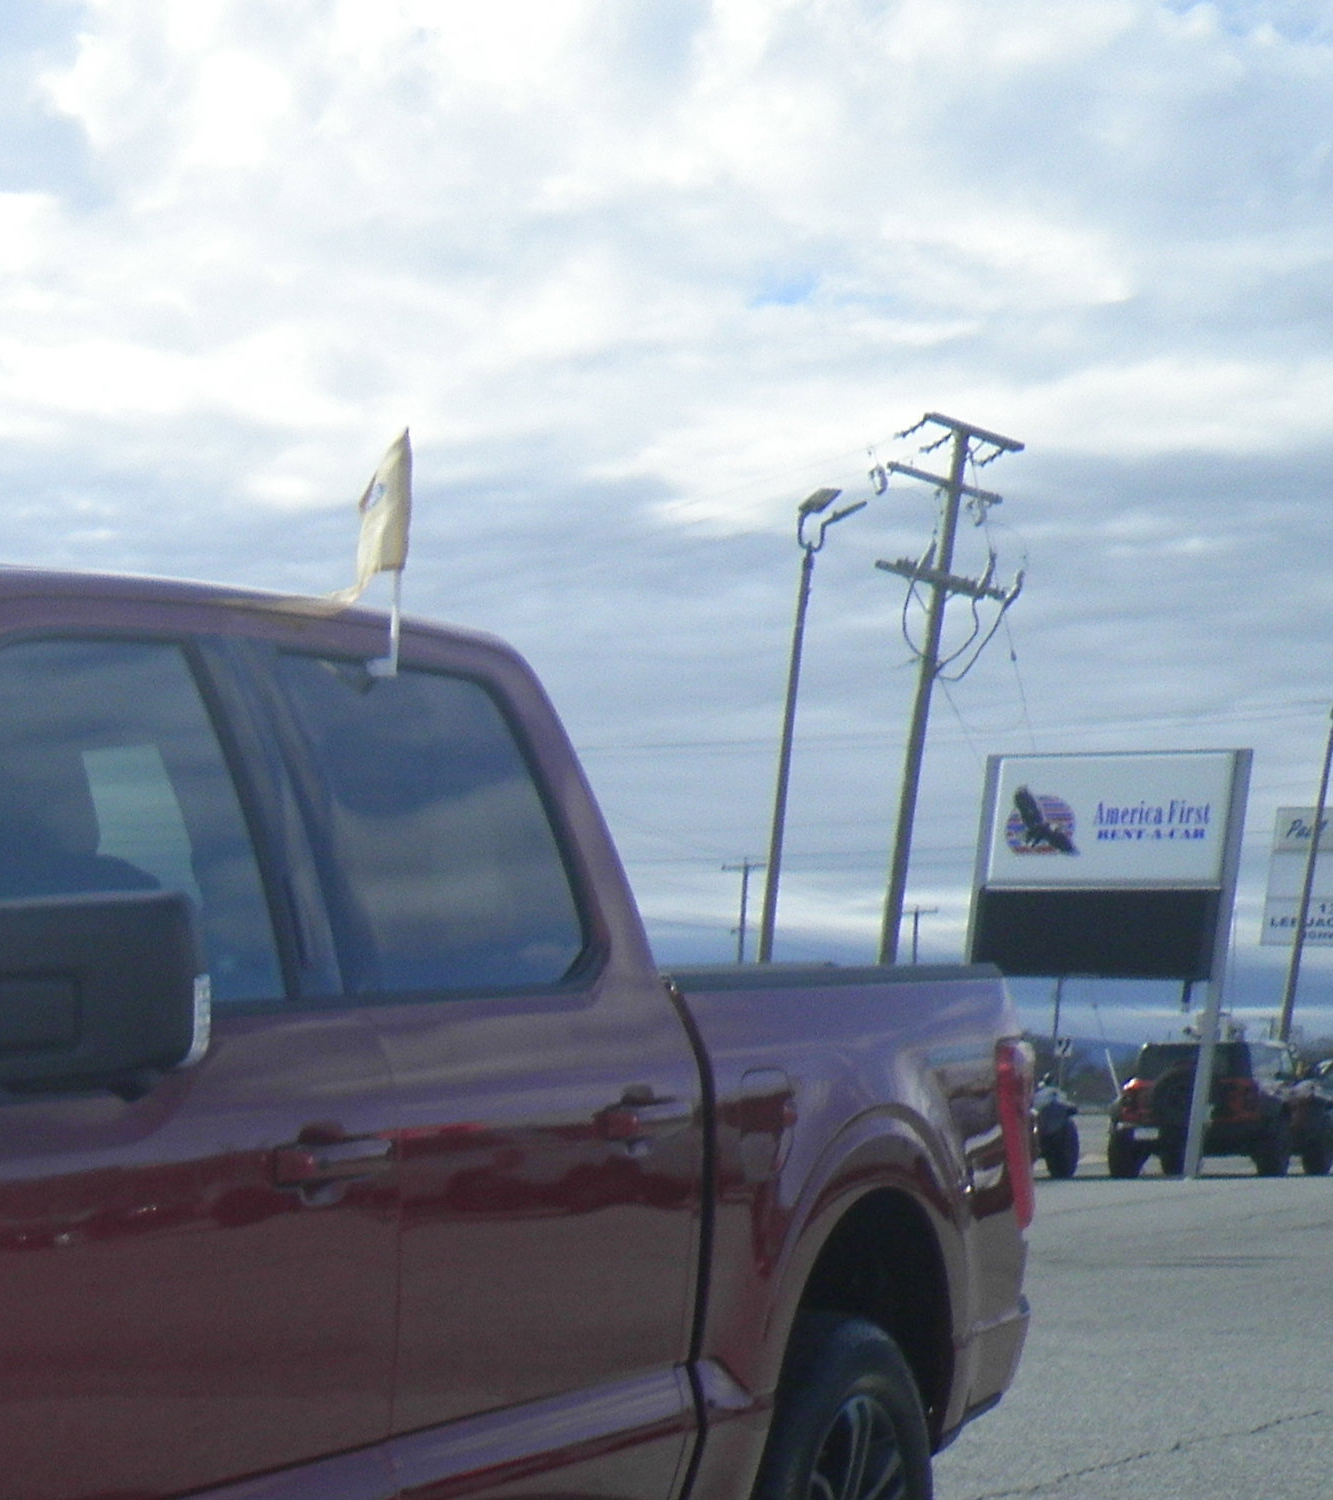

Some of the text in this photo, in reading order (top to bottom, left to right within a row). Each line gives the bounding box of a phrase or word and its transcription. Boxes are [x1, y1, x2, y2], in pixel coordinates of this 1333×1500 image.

[1094, 799, 1210, 825] America First
[1098, 829, 1205, 840] RENT-A-CAR
